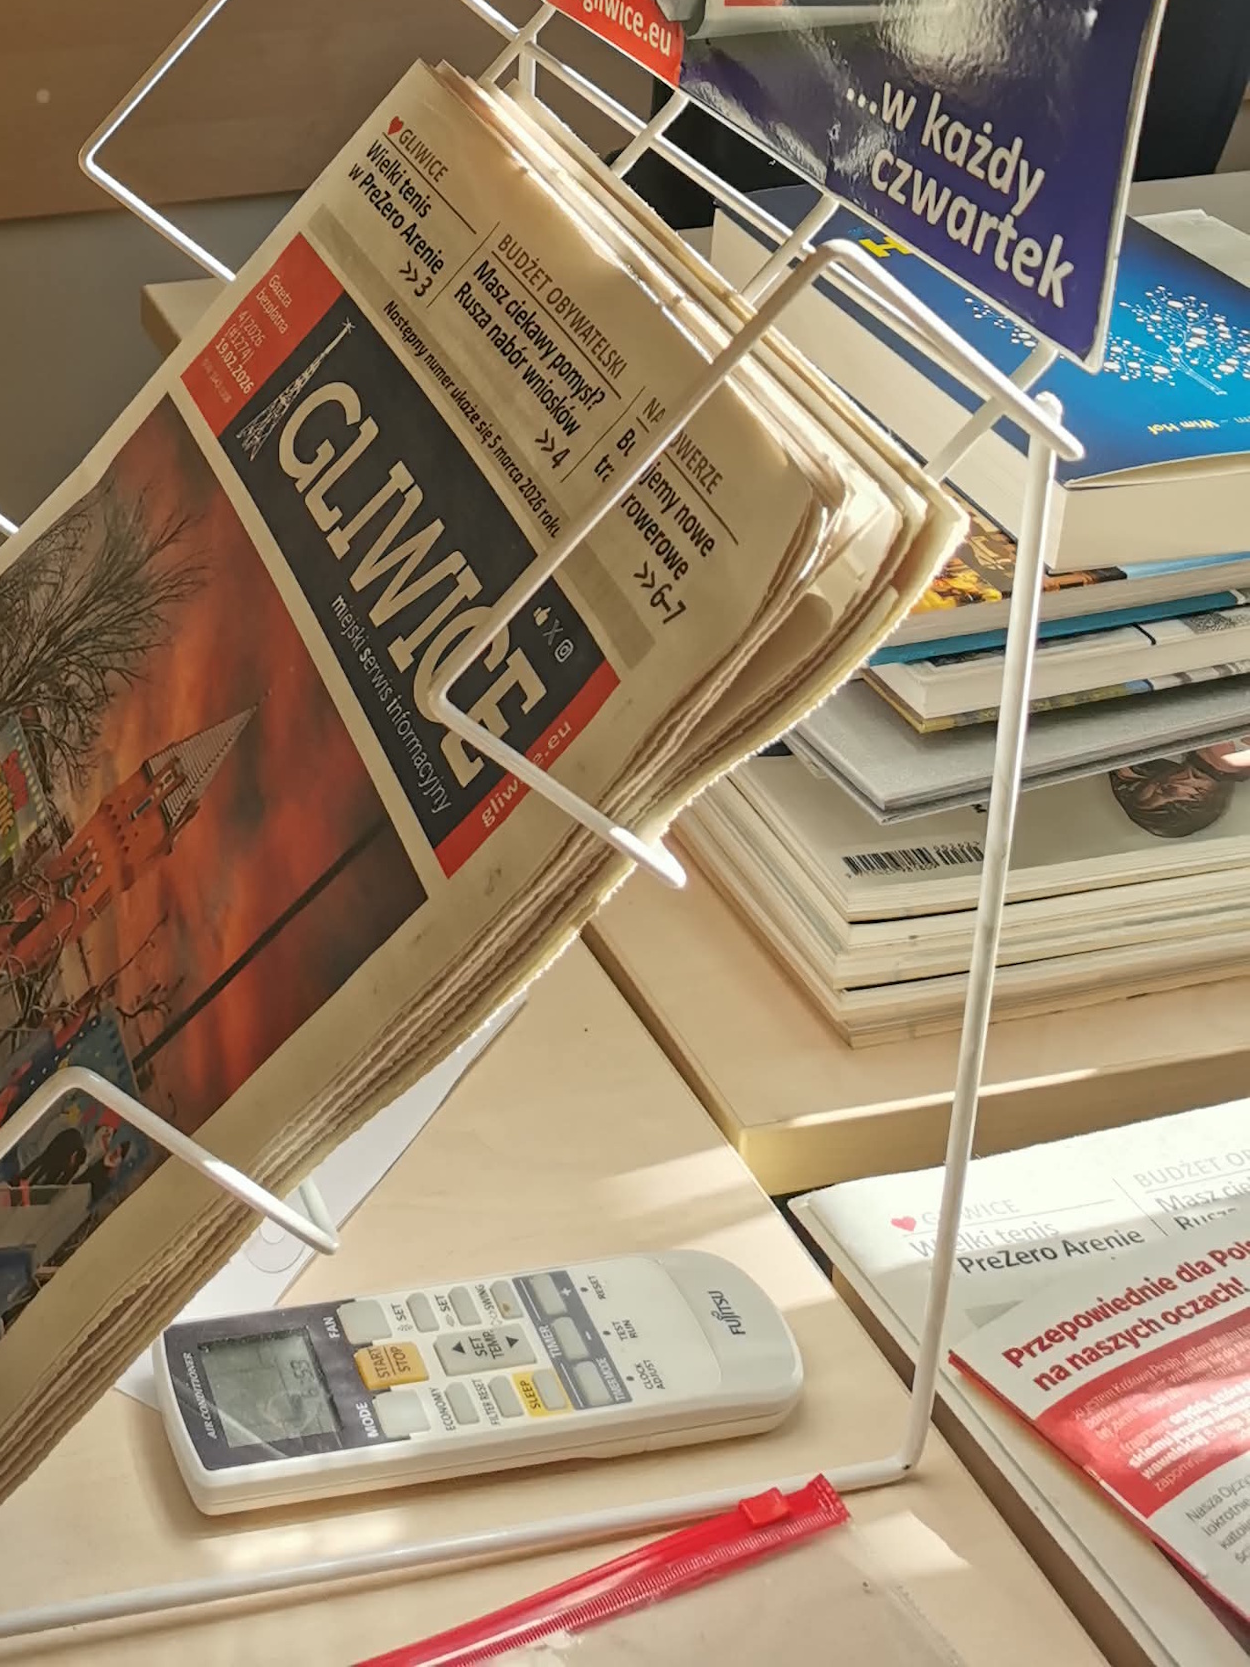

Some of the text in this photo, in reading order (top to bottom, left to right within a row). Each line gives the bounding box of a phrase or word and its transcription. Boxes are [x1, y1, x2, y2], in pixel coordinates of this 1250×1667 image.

[399, 128, 449, 184] GLIWICE
[925, 85, 1046, 210] każdy
[366, 138, 433, 219] Wielki tenis
[348, 162, 445, 276] w PreZero Arenie
[873, 150, 1076, 309] czwartek
[268, 274, 293, 309] Gazeta
[497, 233, 628, 380] BUDŻET OBYWATELSKI
[382, 300, 429, 358] Następny
[473, 260, 511, 306] Masz
[505, 300, 559, 362] ciekawy
[547, 352, 606, 412] pomysł?
[214, 337, 256, 396] 19.02.2026
[423, 351, 455, 391] numer
[454, 280, 582, 437] Rusza nabór wniosków
[449, 387, 480, 425] ukaże
[477, 422, 494, 445] się
[487, 434, 501, 450] 5
[493, 443, 525, 485] marca
[518, 476, 545, 513] 2026
[620, 492, 689, 581] rowerowe
[674, 502, 716, 558] nowe
[278, 380, 548, 789] GLIWICE
[331, 593, 453, 814] miejski serwis informacyjny
[920, 1198, 1021, 1227] GWICE
[957, 1227, 1147, 1275] PreZero Arenie
[434, 1294, 451, 1312] SET
[475, 1284, 493, 1311] SWING
[587, 1274, 606, 1300] RESET
[322, 1315, 341, 1340] FAN
[391, 1303, 408, 1322] SET
[611, 1320, 627, 1342] TEST
[622, 1318, 639, 1339] RUN
[707, 1290, 747, 1336] FUJITSU
[1001, 1276, 1178, 1369] Przepowiednie
[1175, 1260, 1217, 1284] dla
[469, 1335, 488, 1358] SET
[539, 1324, 563, 1359] TIMER
[1033, 1363, 1073, 1392] na
[1065, 1317, 1166, 1371] naszych
[1160, 1276, 1250, 1326] oczach!
[367, 1347, 390, 1379] START
[392, 1345, 412, 1374] STOP
[634, 1362, 654, 1390] CLOCK
[643, 1358, 667, 1391] ADJUST
[182, 1351, 218, 1440] AIR CONDITIONER
[429, 1386, 457, 1432] ECONOMY
[471, 1378, 501, 1427] FILTER RESET
[519, 1379, 542, 1410] SLEEP
[605, 1377, 627, 1403] TIMER
[356, 1401, 381, 1440] MODE
